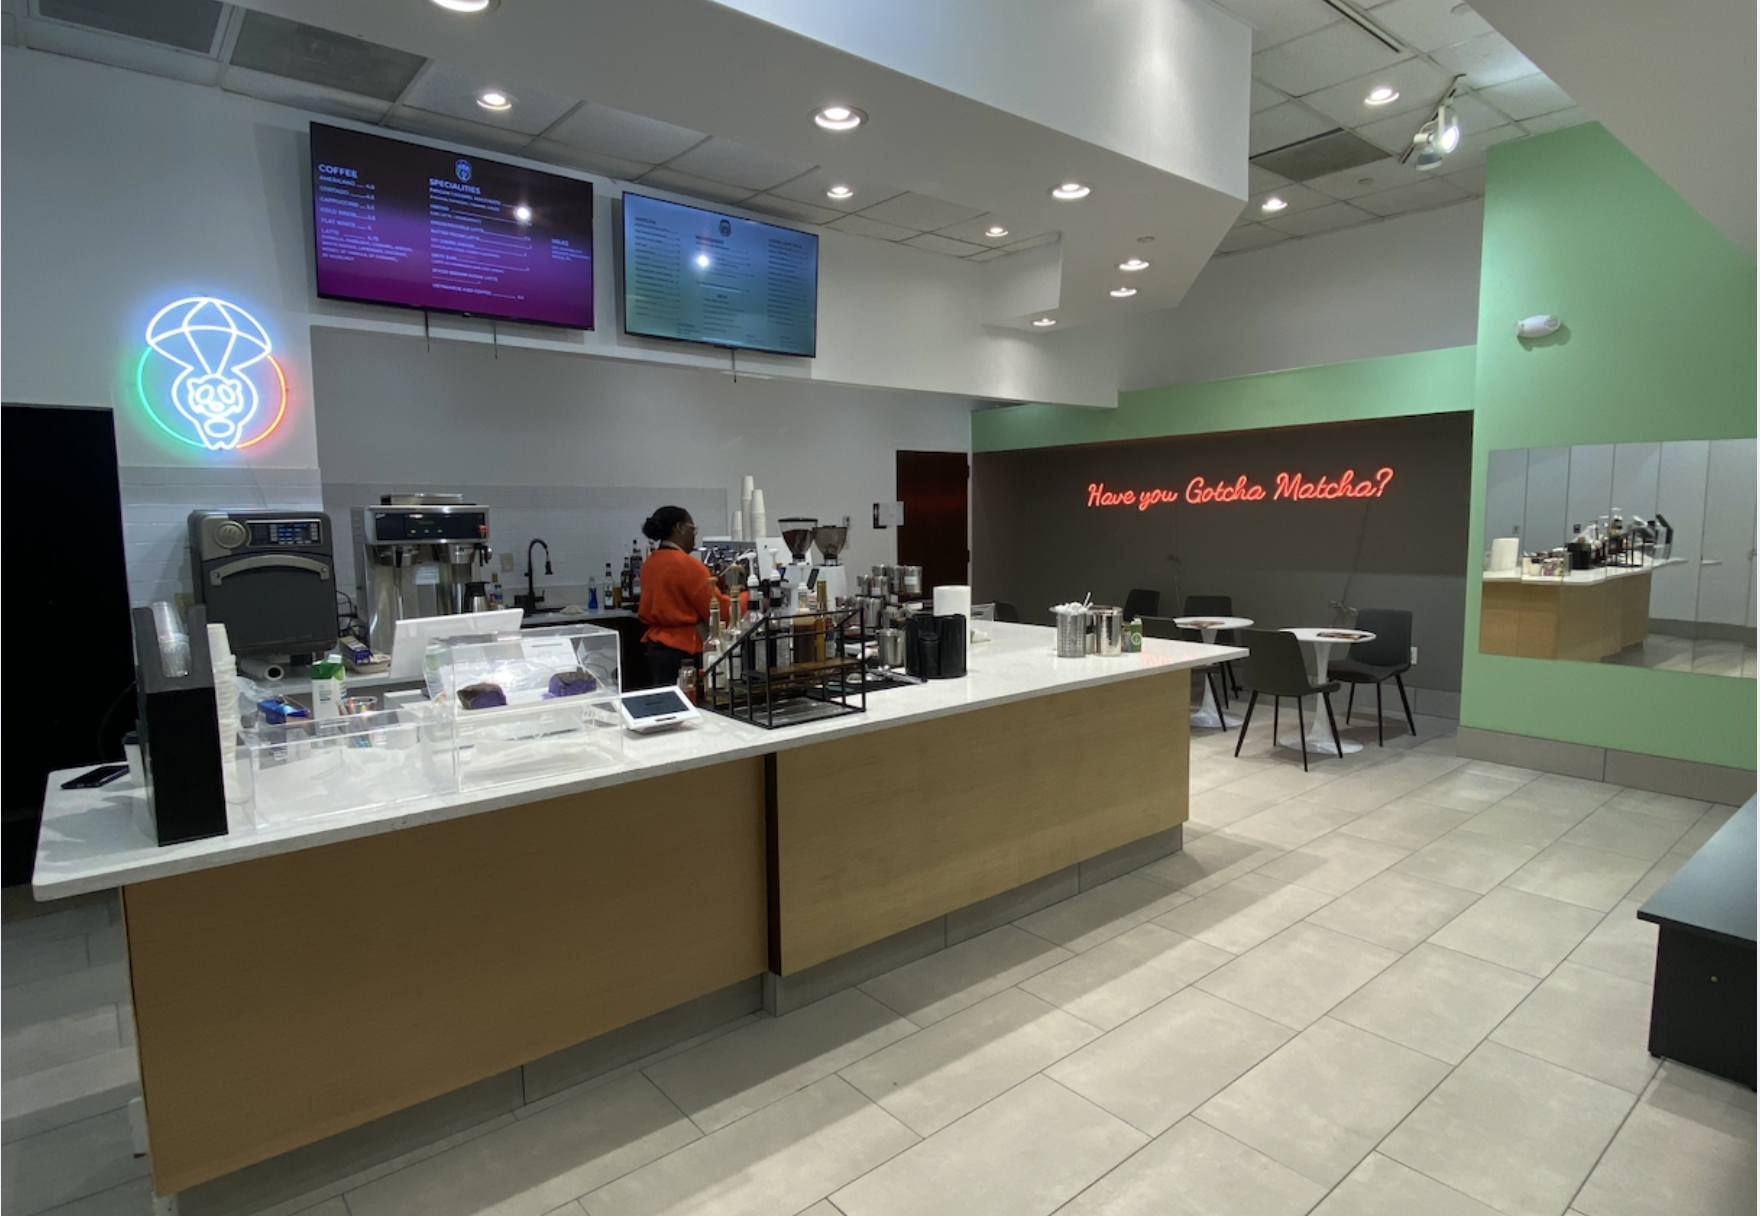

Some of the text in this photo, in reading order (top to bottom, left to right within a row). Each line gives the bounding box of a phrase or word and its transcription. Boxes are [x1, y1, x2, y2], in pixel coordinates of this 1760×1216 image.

[318, 163, 358, 179] COFFEE
[319, 175, 356, 187] AMERICANO
[428, 177, 481, 195] SPECIALITIES
[1087, 467, 1394, 511] Have you Gotcha Matcha?
